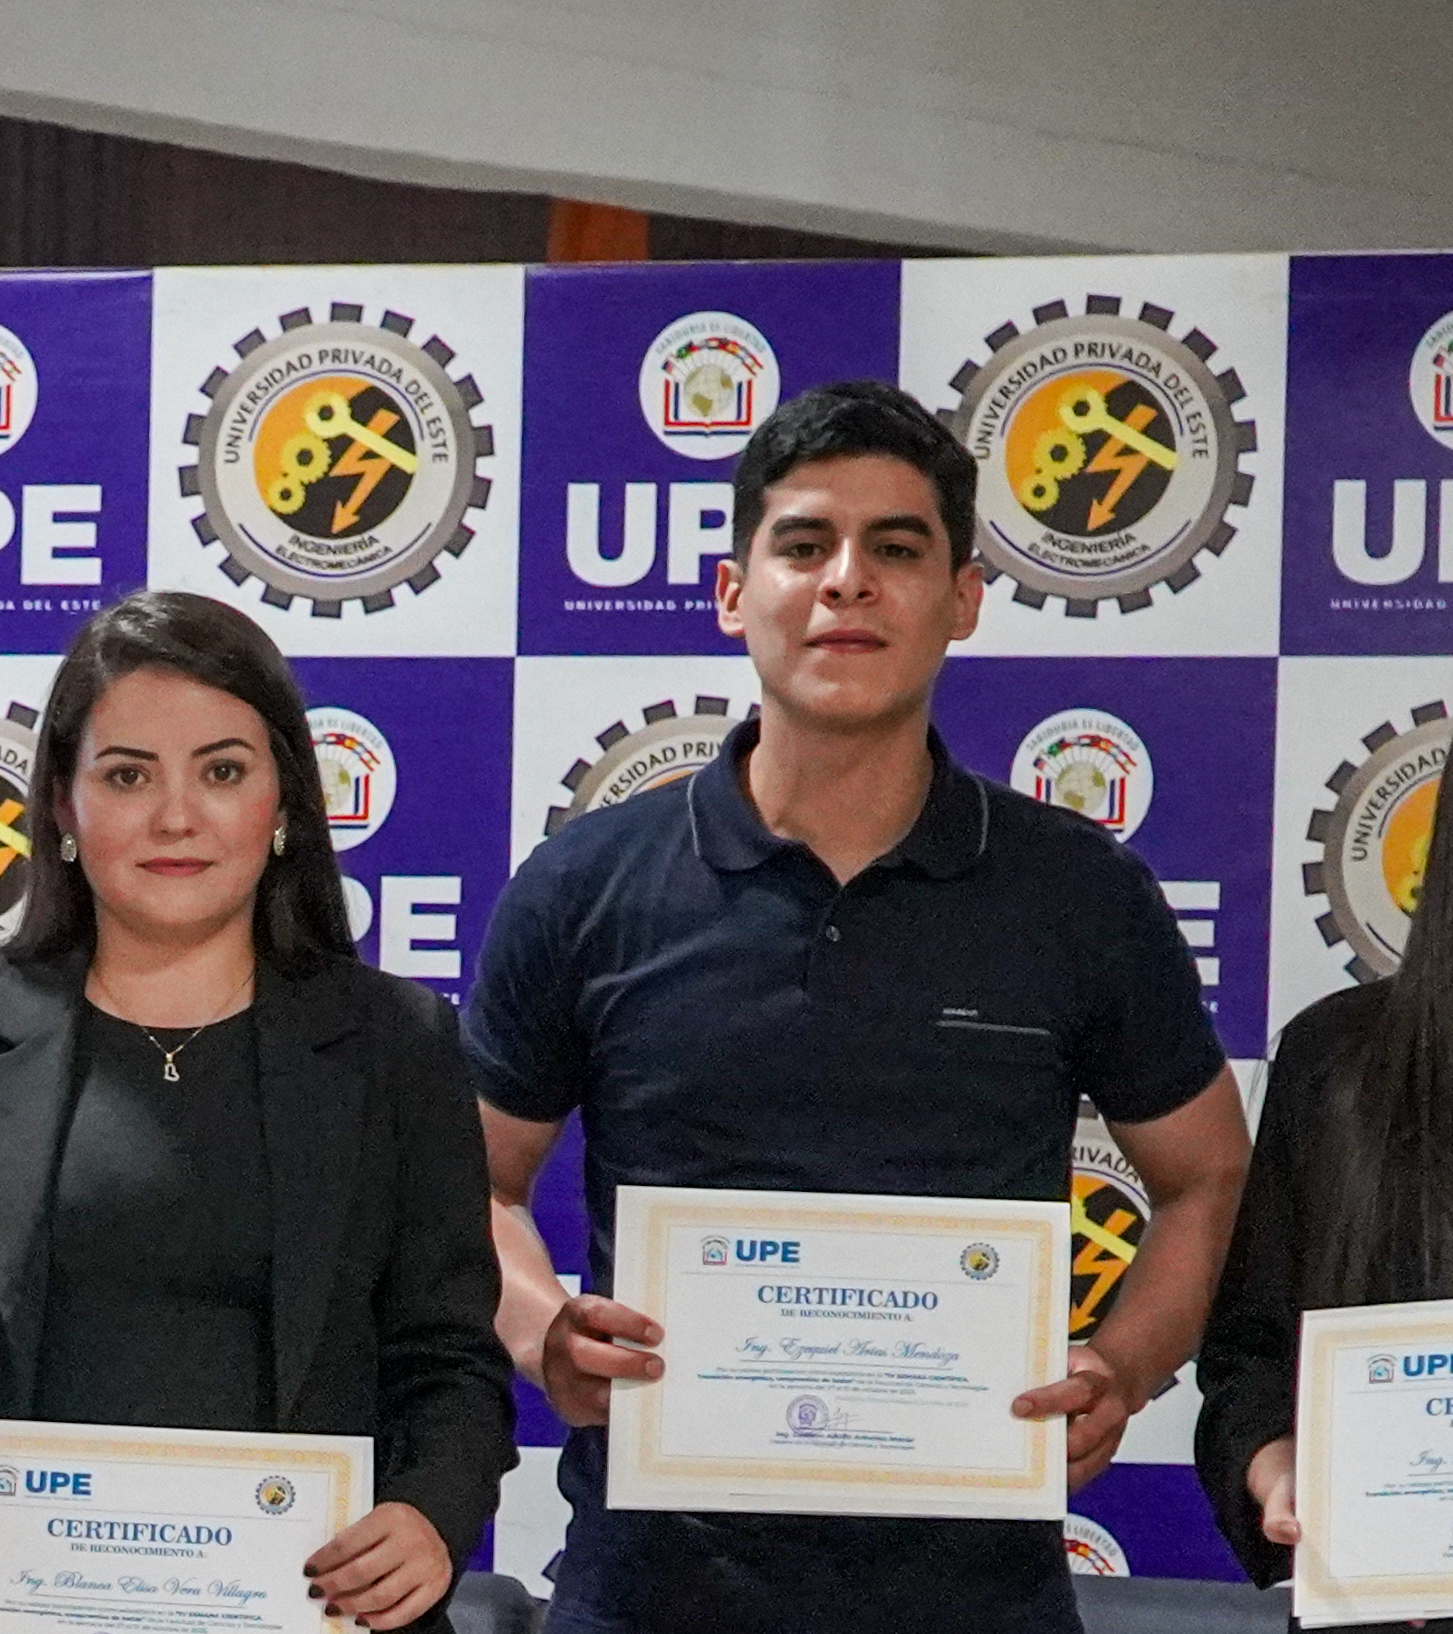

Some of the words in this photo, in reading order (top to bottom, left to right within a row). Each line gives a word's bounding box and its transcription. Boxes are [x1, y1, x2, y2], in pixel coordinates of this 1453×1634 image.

[224, 353, 313, 464] UNIVERSIDAD
[318, 348, 403, 385] PRIVADA
[404, 380, 433, 414] DEL
[426, 416, 448, 463] ESTE
[975, 346, 1068, 460] UNIVERSIDAD
[1073, 342, 1162, 378] PRIVADA
[1163, 372, 1193, 408] DEL
[1187, 411, 1209, 458] ESTE
[566, 482, 735, 587] UP
[564, 600, 677, 611] UNIVERSIDAD
[601, 746, 677, 804] ERSIDAD
[1351, 747, 1447, 861] UNIVERSIDAD
[1072, 1146, 1140, 1183] RIVADA
[736, 1239, 801, 1263] UPE
[757, 1285, 938, 1310] CERTIFICADO
[781, 1309, 795, 1317] DE
[25, 1470, 92, 1495] UPE
[47, 1518, 232, 1546] CERTIFICADO
[70, 1543, 87, 1551] DE
